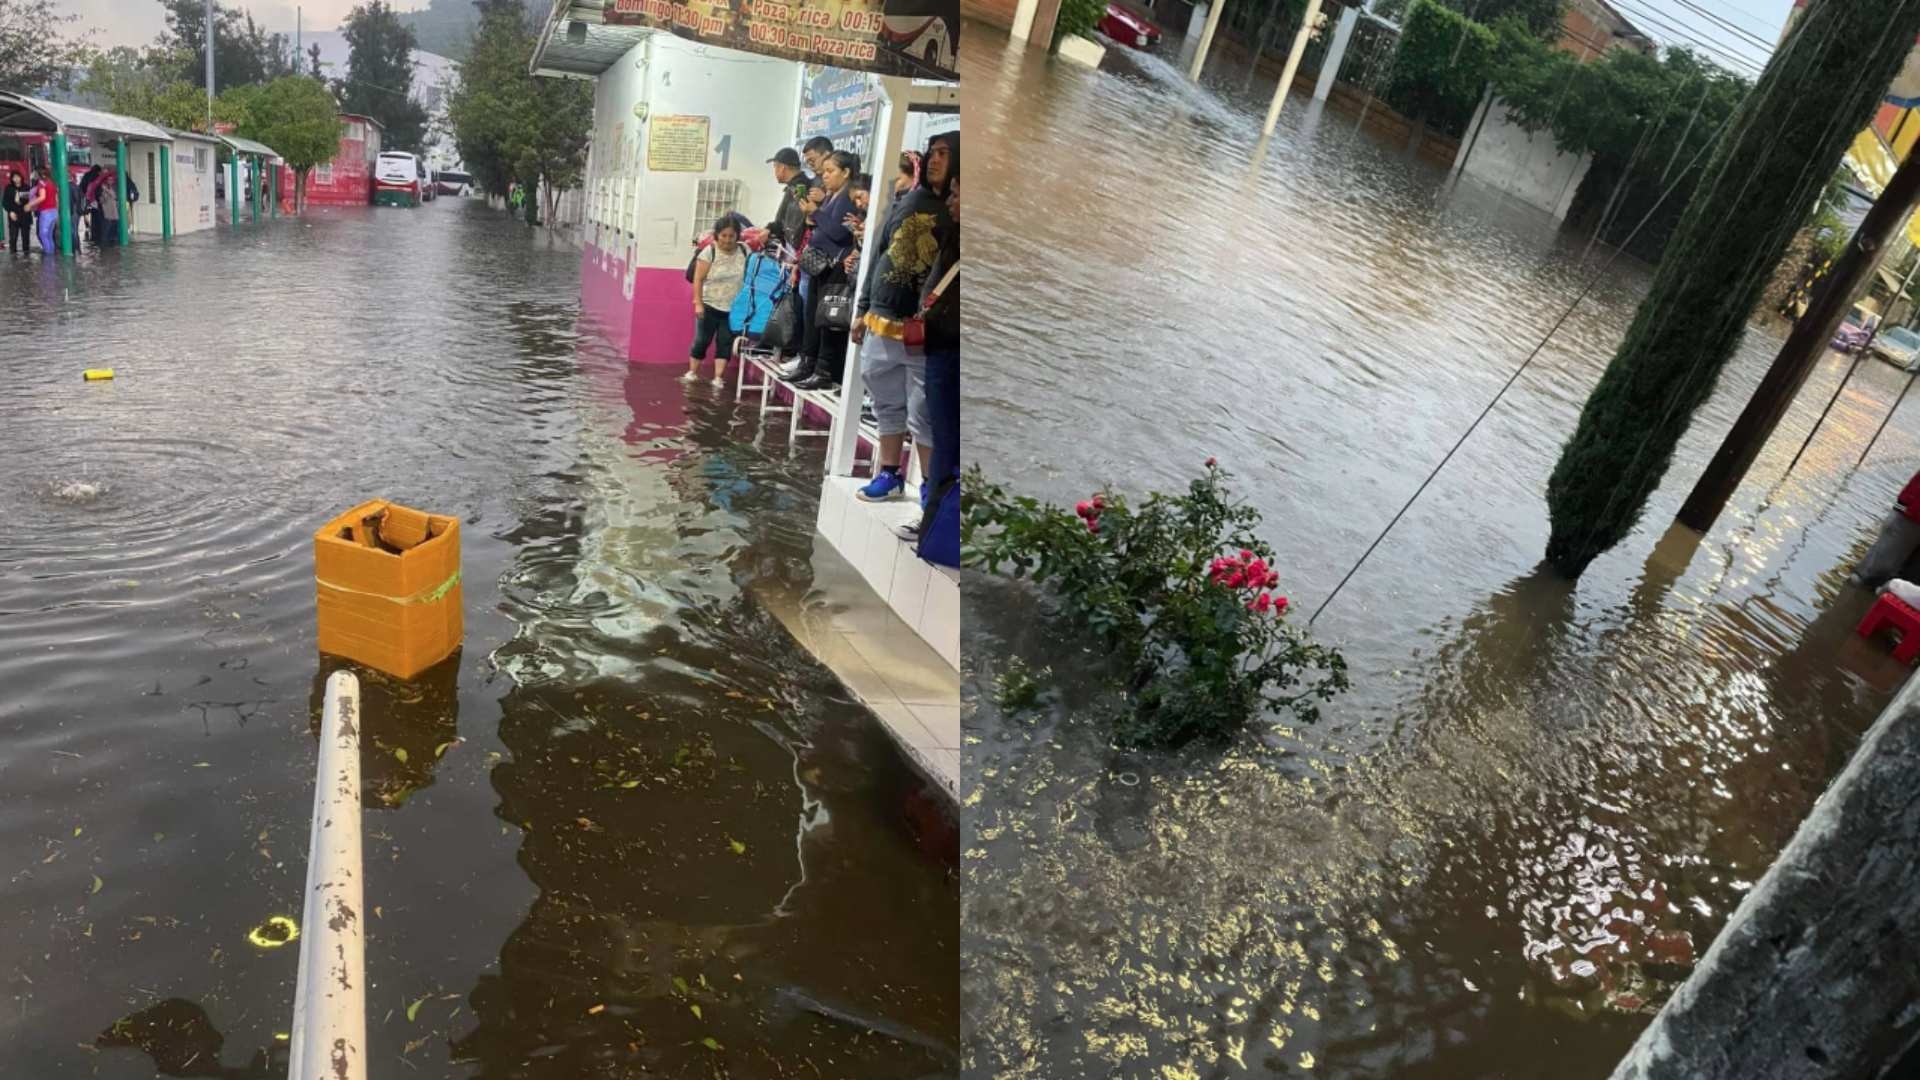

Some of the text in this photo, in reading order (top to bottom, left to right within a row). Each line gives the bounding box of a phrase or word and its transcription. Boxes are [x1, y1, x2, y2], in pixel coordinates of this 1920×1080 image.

[752, 0, 788, 21] Poza
[799, 6, 832, 28] rica
[841, 11, 884, 33] 00:15
[750, 23, 876, 60] 00:30 am Poza rica
[714, 134, 732, 171] 1
